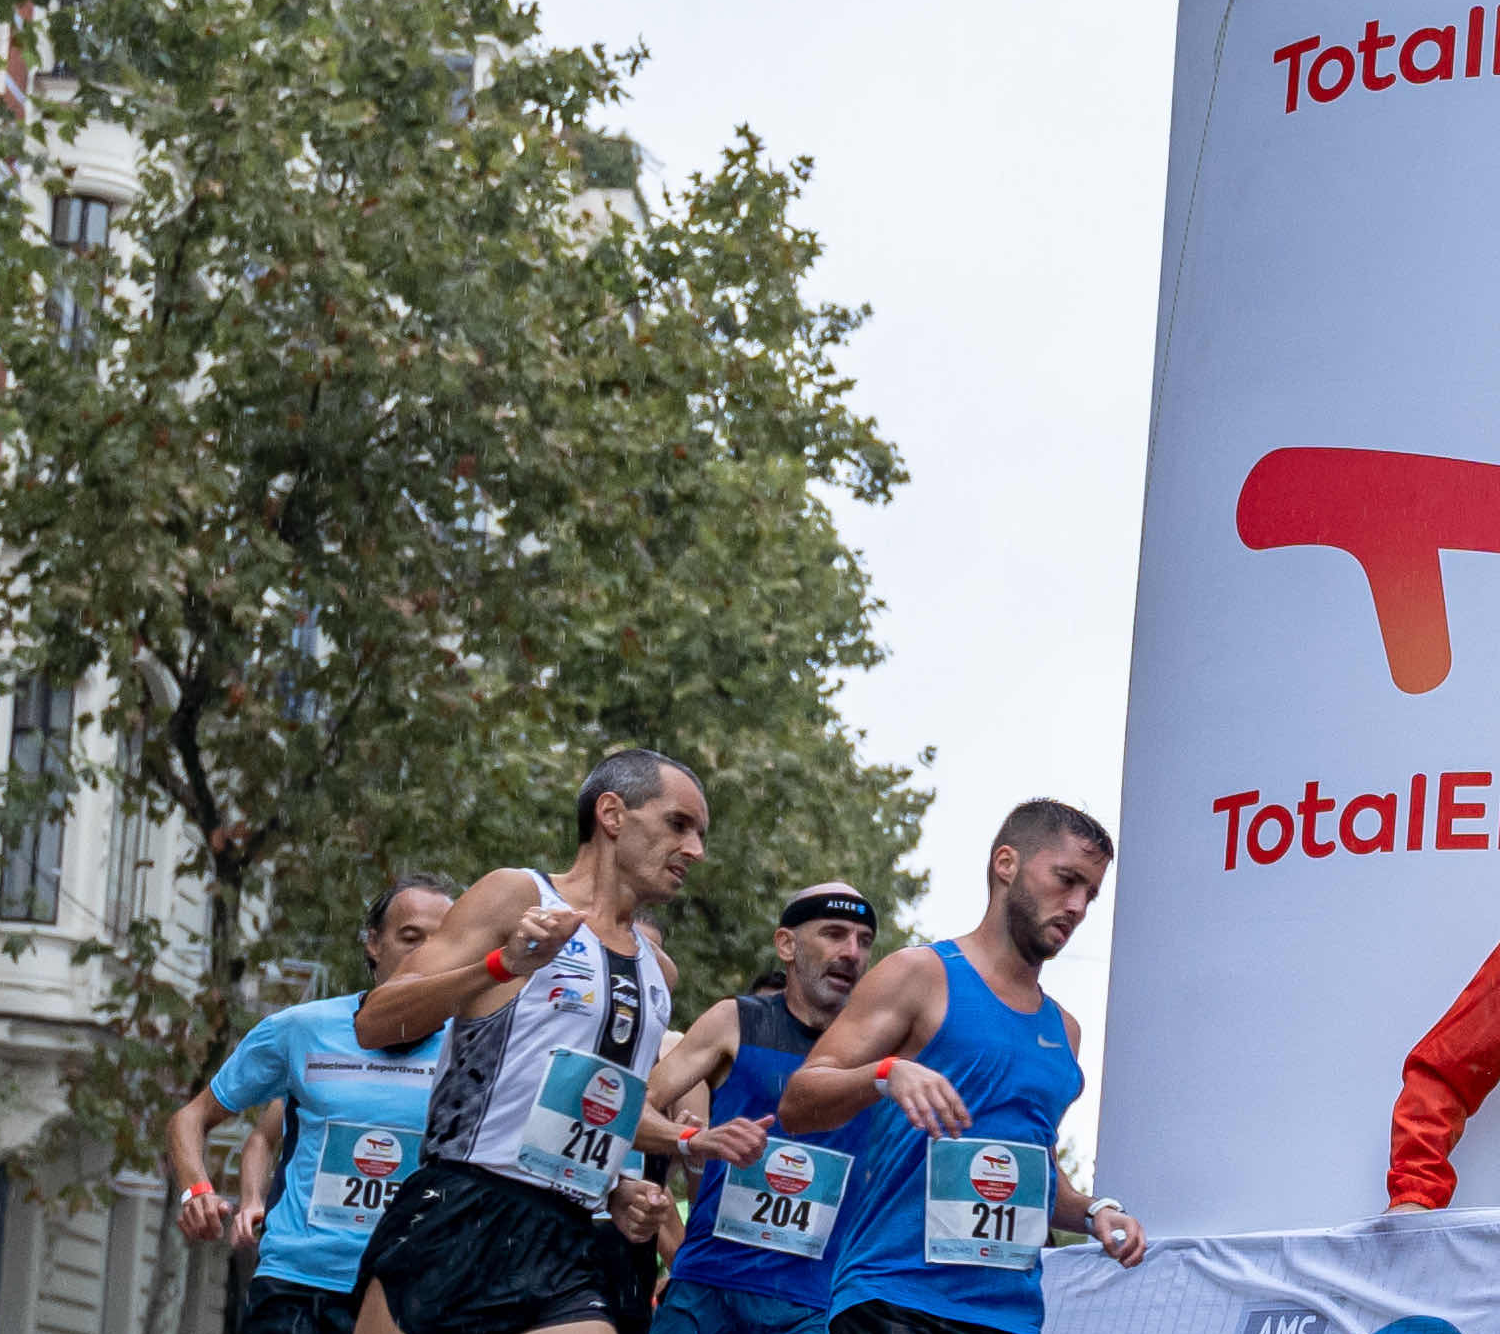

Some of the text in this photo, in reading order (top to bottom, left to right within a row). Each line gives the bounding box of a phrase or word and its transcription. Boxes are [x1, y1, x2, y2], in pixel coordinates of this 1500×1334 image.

[561, 1121, 614, 1171] 214
[751, 1191, 812, 1232] 204
[972, 1202, 1016, 1242] 211
